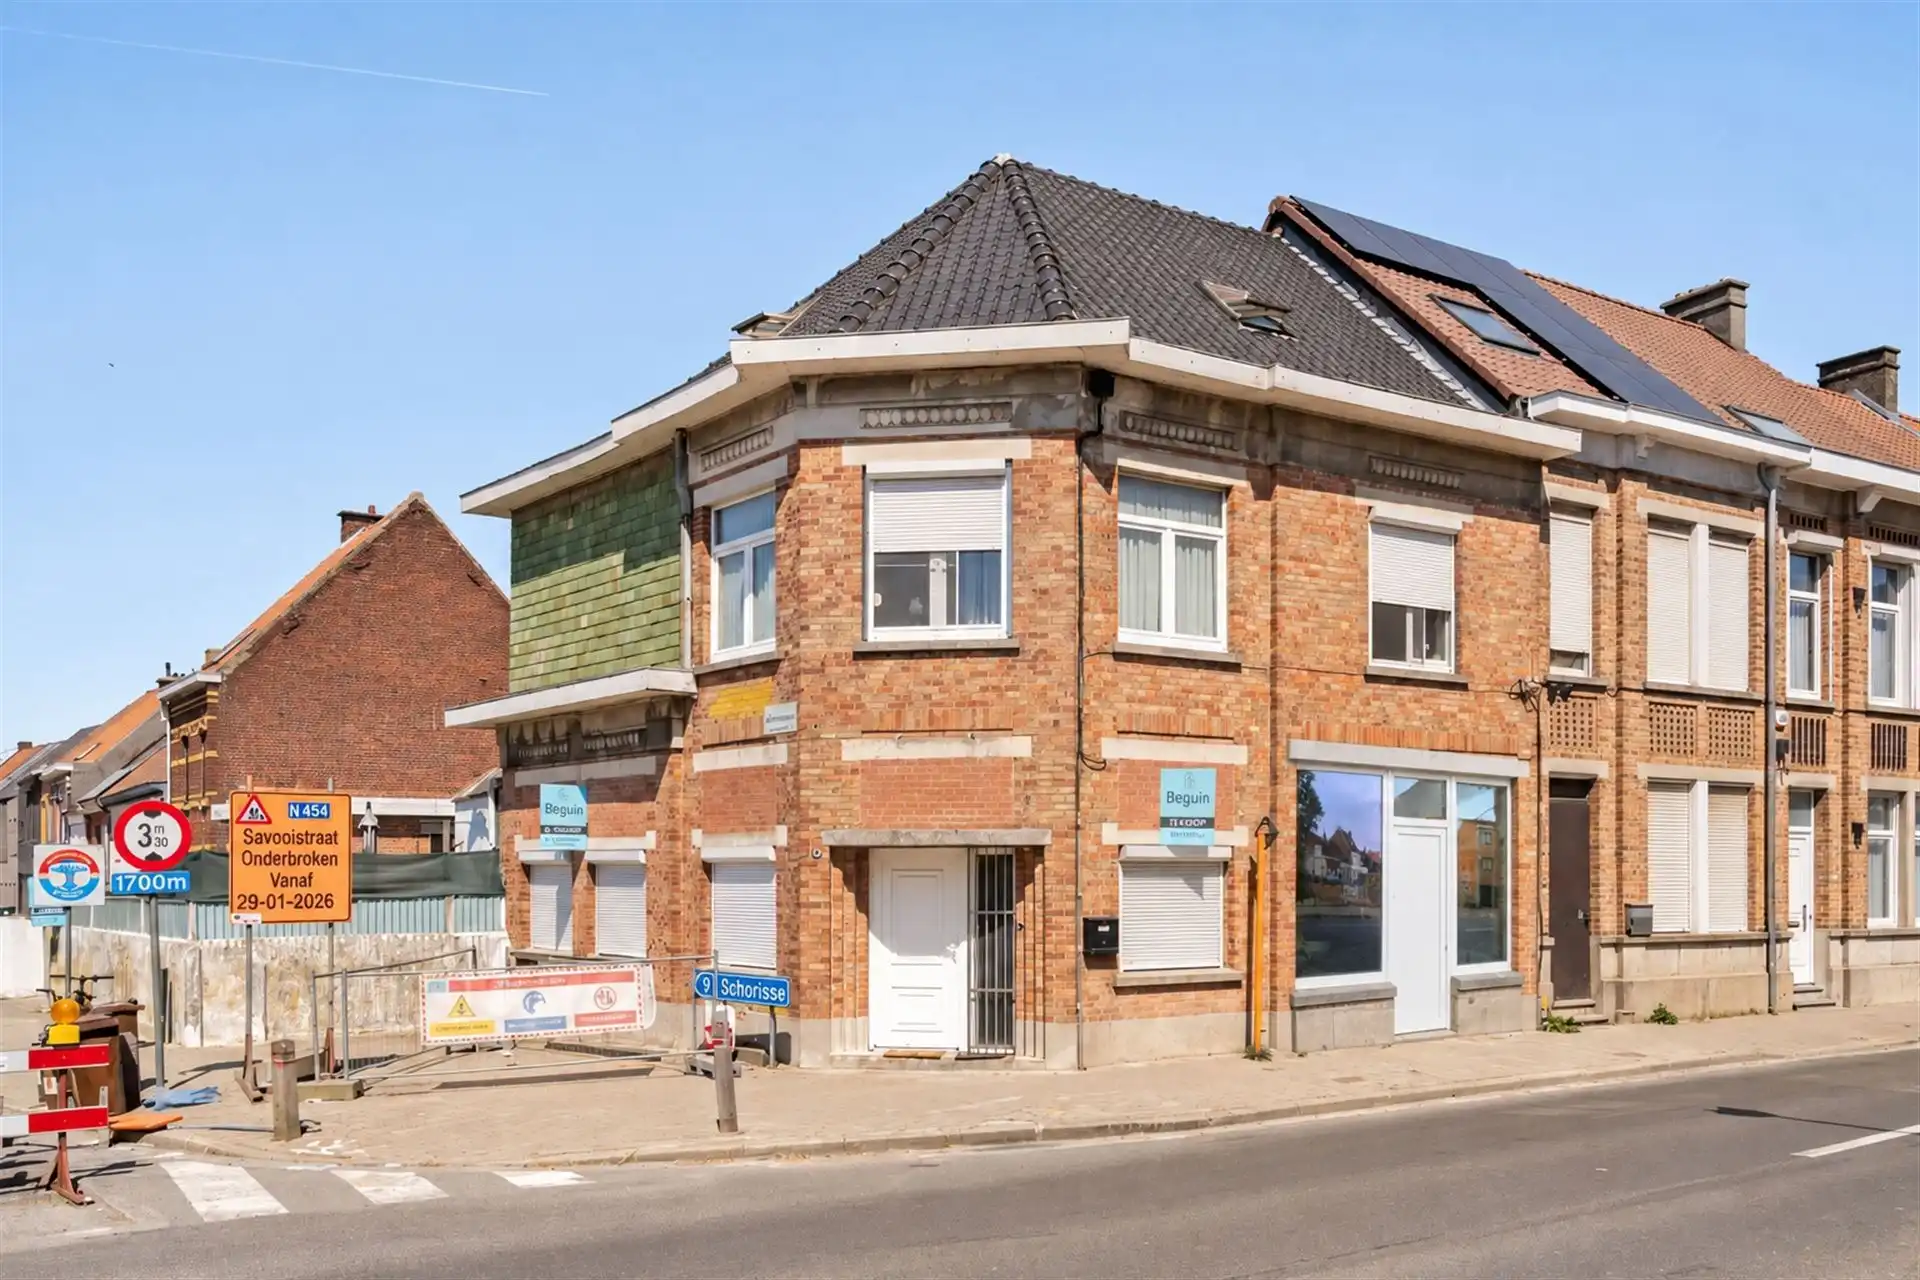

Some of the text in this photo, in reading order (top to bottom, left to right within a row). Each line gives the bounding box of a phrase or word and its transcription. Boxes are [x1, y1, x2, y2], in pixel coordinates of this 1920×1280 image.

[1166, 791, 1210, 807] Beguin
[289, 804, 328, 817] N 454
[545, 803, 584, 818] Beguin
[137, 823, 152, 848] 3
[154, 837, 169, 848] 30
[243, 828, 339, 845] Savooistraat
[241, 849, 338, 866] Onderbroken
[115, 874, 187, 892] 1700m
[270, 871, 314, 888] Vanaf
[237, 893, 334, 910] 29-01-2026
[702, 976, 786, 1002] 9 Schorisse
